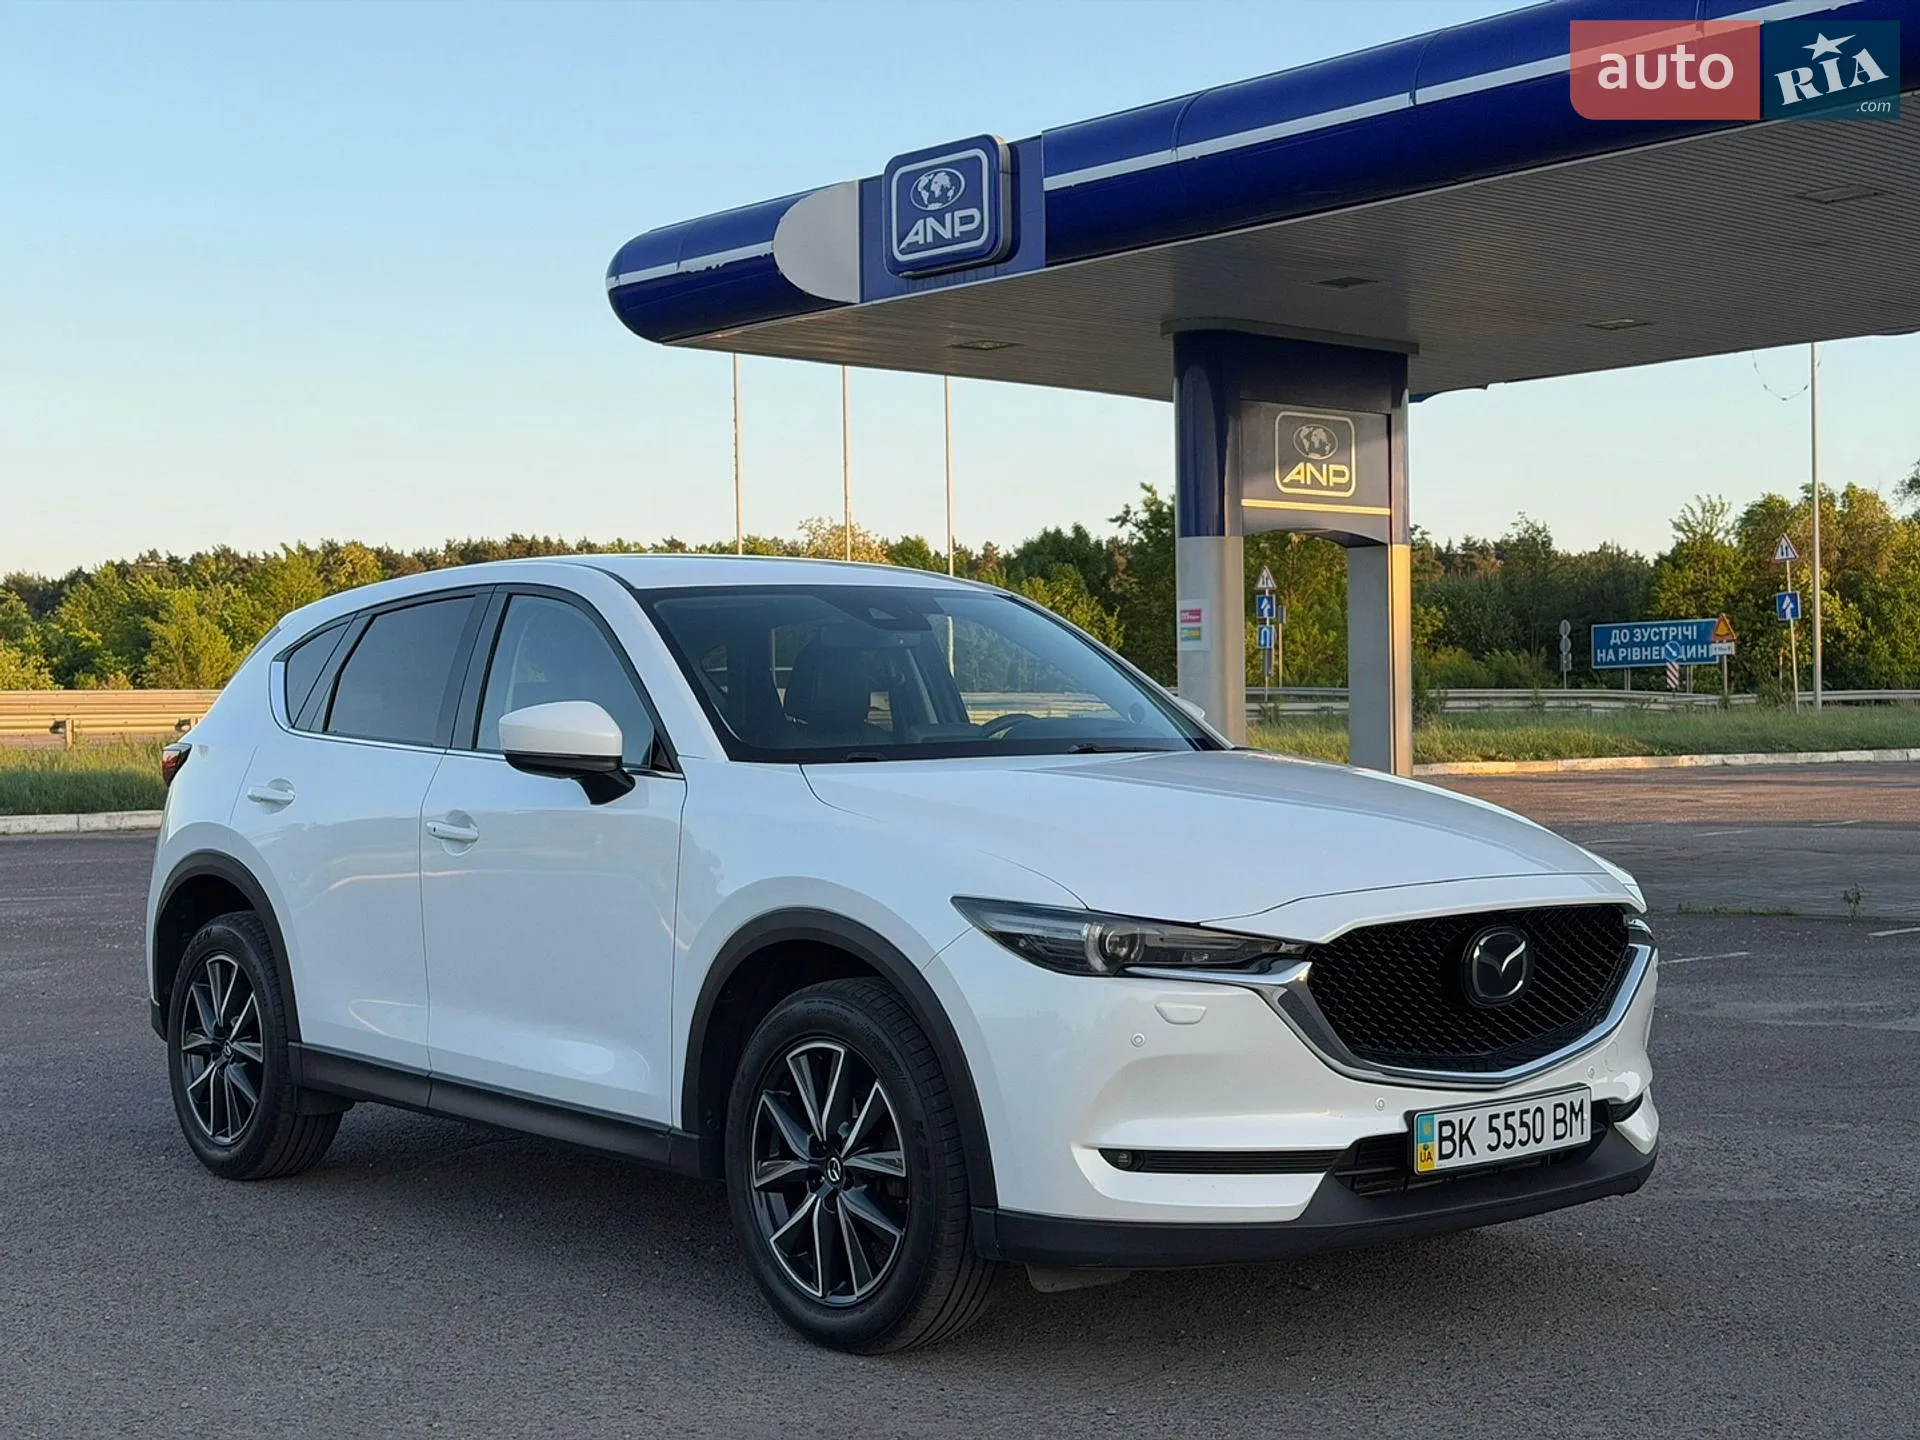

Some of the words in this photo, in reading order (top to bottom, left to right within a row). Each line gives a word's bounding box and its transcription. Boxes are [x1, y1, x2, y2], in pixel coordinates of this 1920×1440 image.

[899, 208, 982, 250] ANP
[1283, 462, 1350, 487] ANP
[1610, 629, 1630, 645] ДО
[1633, 624, 1697, 642] ЗУСТРІЧІ
[1597, 648, 1616, 662] НА
[1438, 1116, 1476, 1161] BK
[1487, 1106, 1544, 1152] 5550
[1553, 1098, 1584, 1141] BM
[1420, 1151, 1433, 1163] UA
